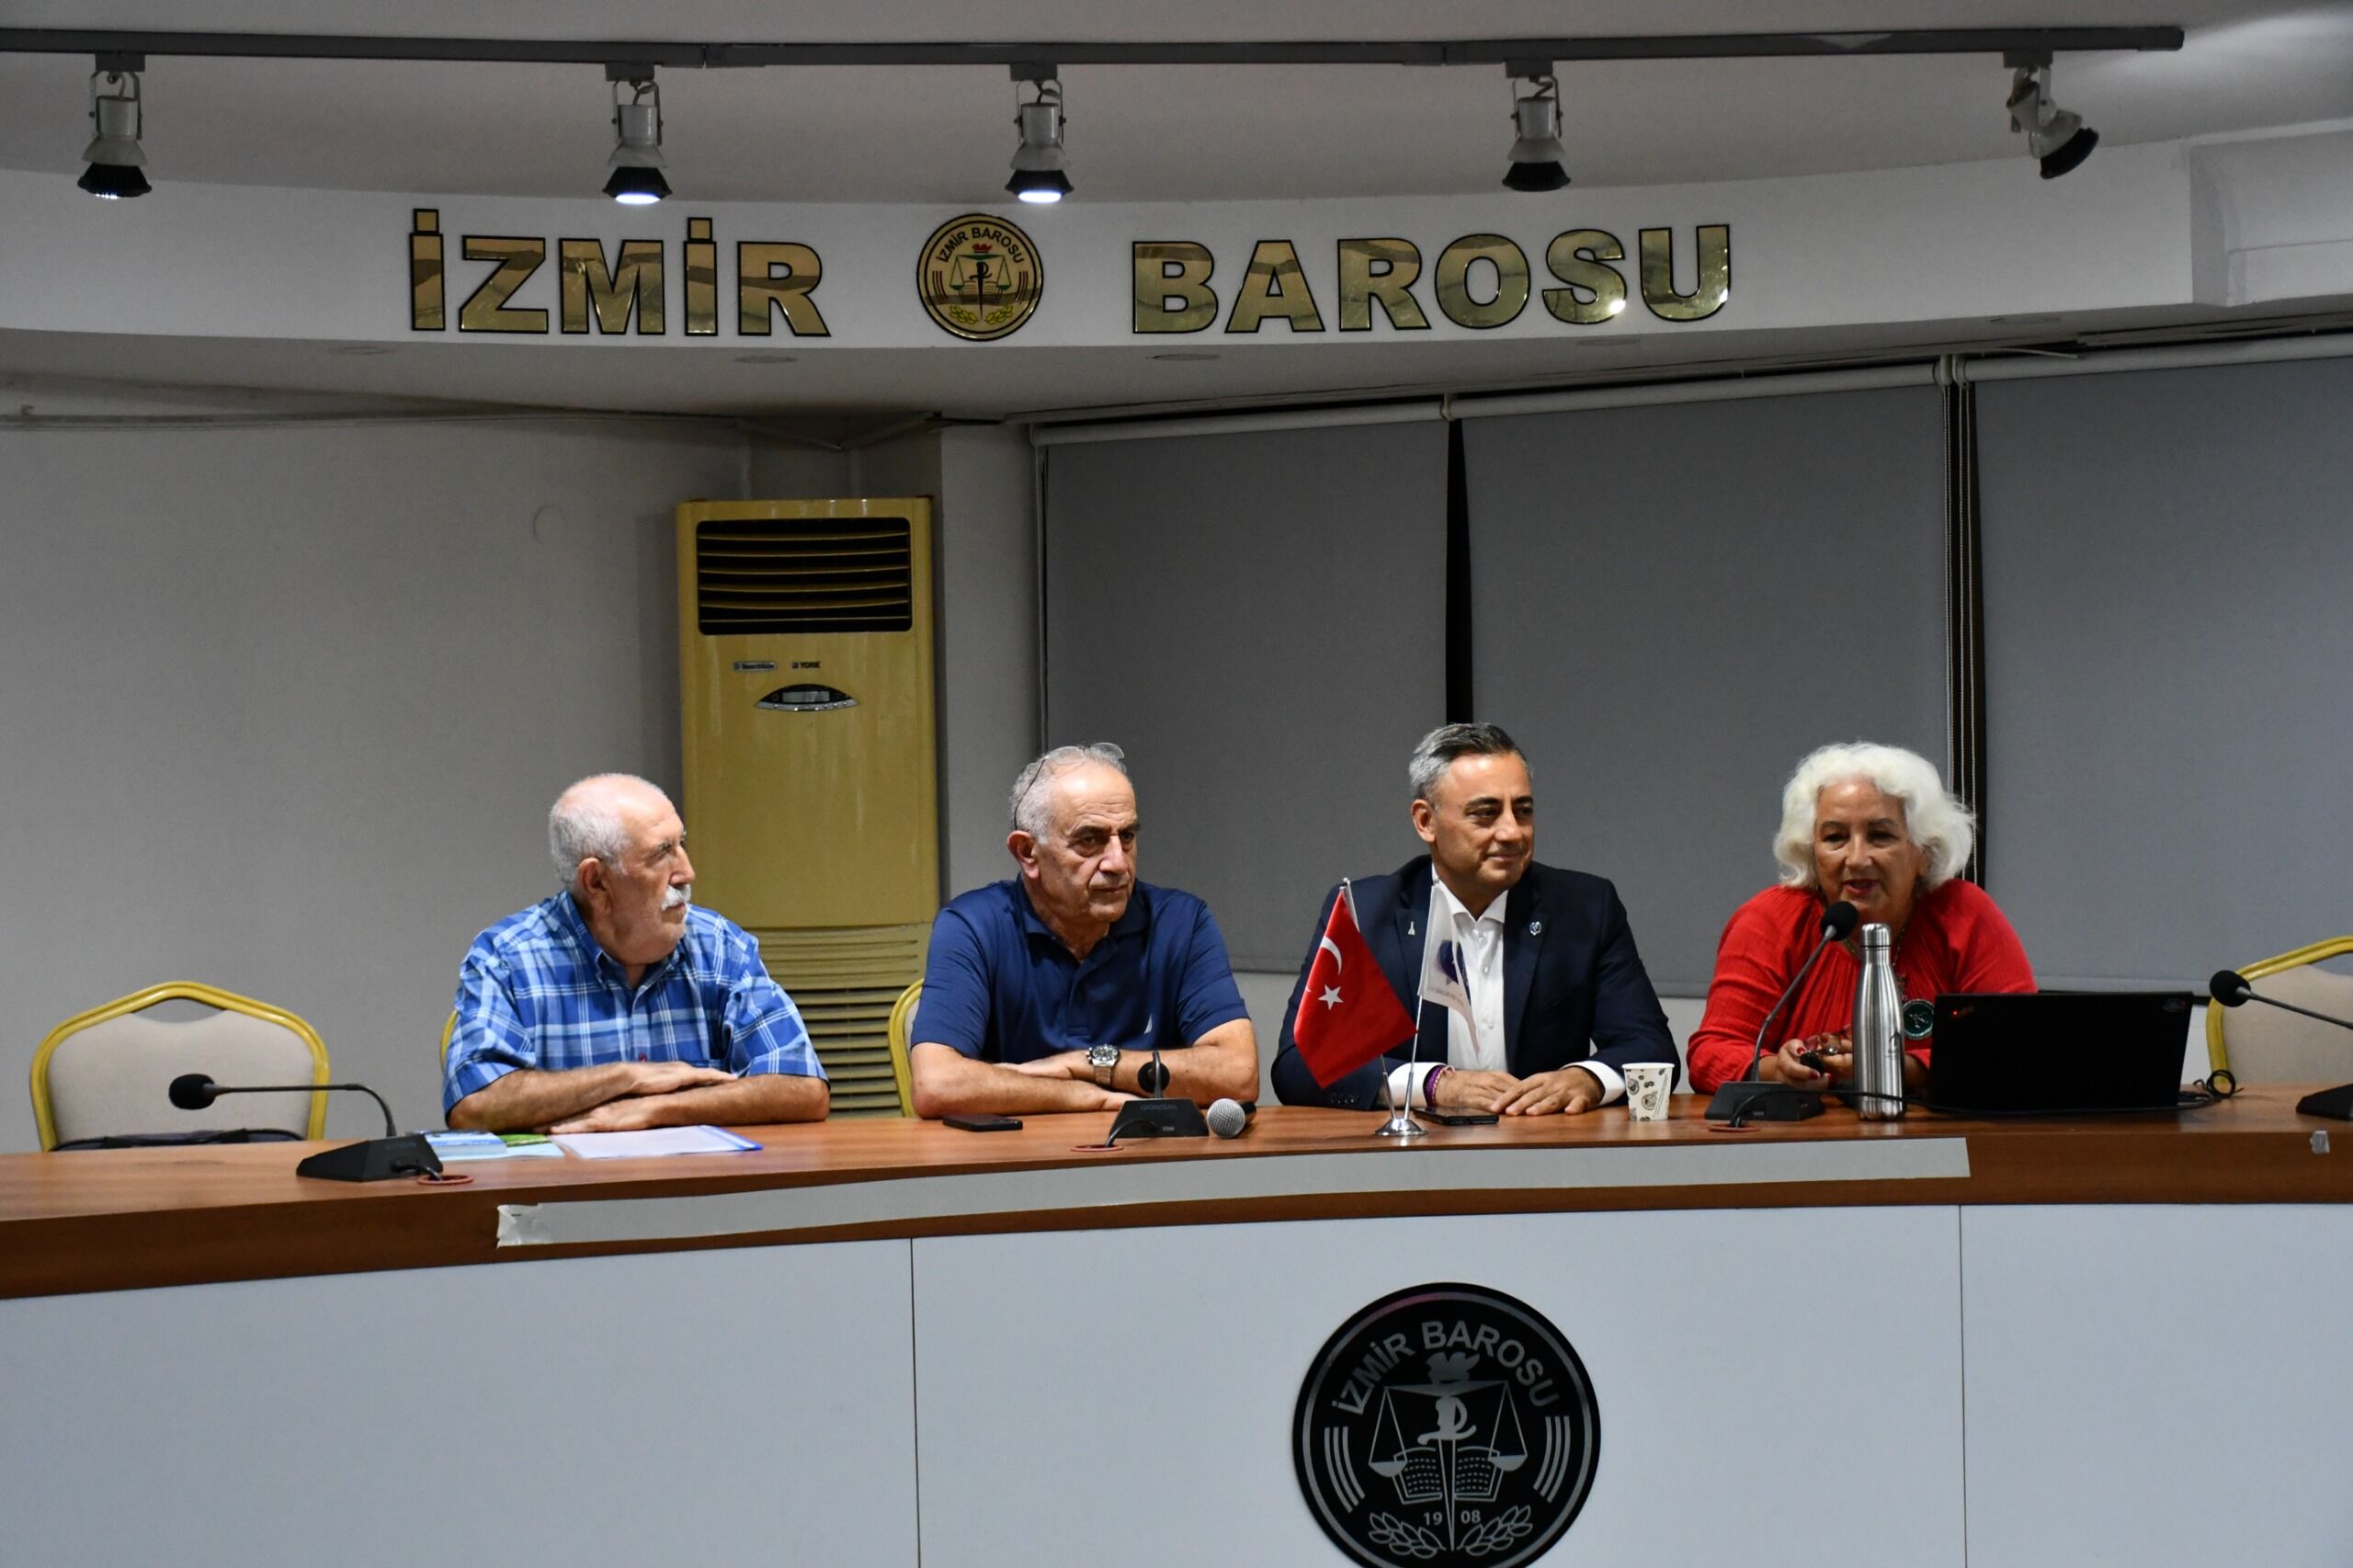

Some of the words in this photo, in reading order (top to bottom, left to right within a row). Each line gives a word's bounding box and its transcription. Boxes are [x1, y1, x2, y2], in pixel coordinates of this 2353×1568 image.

[936, 231, 969, 263] İZMİR
[971, 227, 1025, 264] BAROSU
[409, 209, 832, 337] İZMİR
[1131, 223, 1732, 334] BAROSU
[800, 661, 821, 669] YORK
[1332, 1333, 1416, 1415] İZMİR
[1421, 1320, 1560, 1407] BAROSU
[1424, 1511, 1443, 1526] 19
[1461, 1510, 1482, 1525] 08
